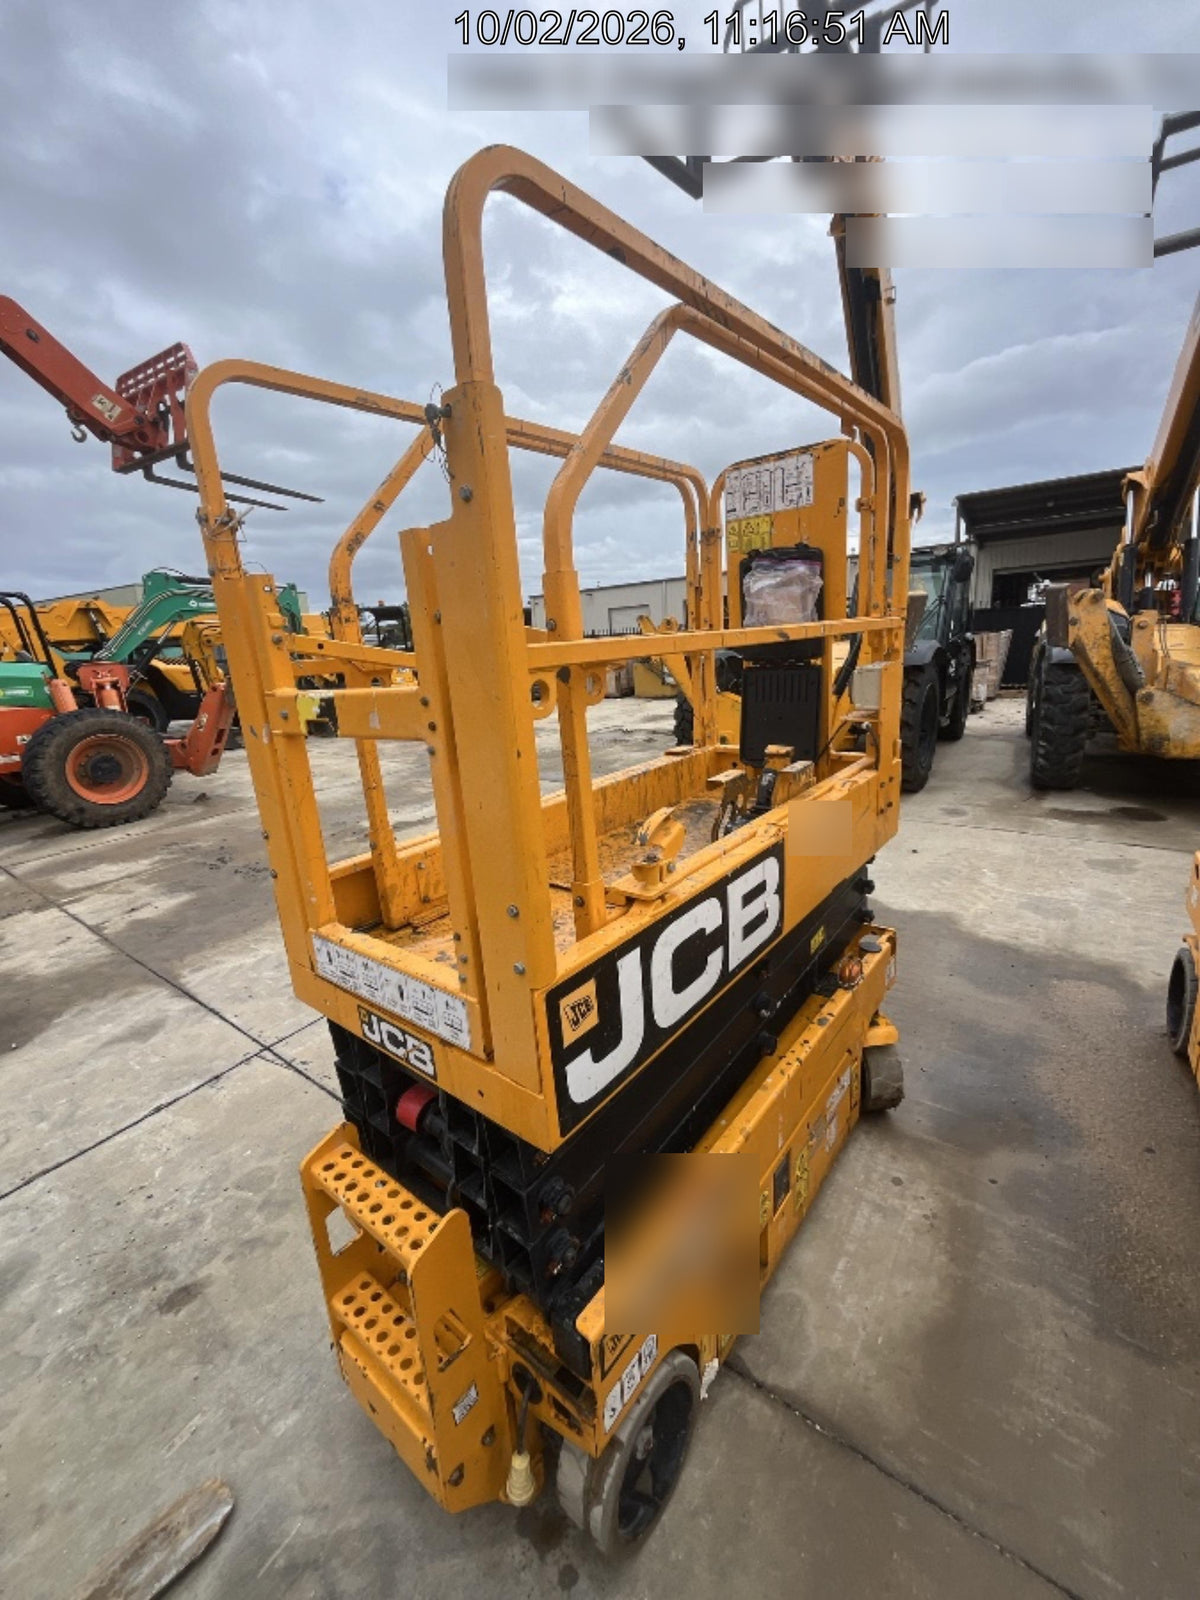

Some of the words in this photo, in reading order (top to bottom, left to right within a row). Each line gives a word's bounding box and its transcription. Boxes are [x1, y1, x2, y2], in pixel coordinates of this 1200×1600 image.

[565, 856, 781, 1105] JCB
[569, 998, 593, 1027] JCB
[362, 1014, 435, 1076] JCB
